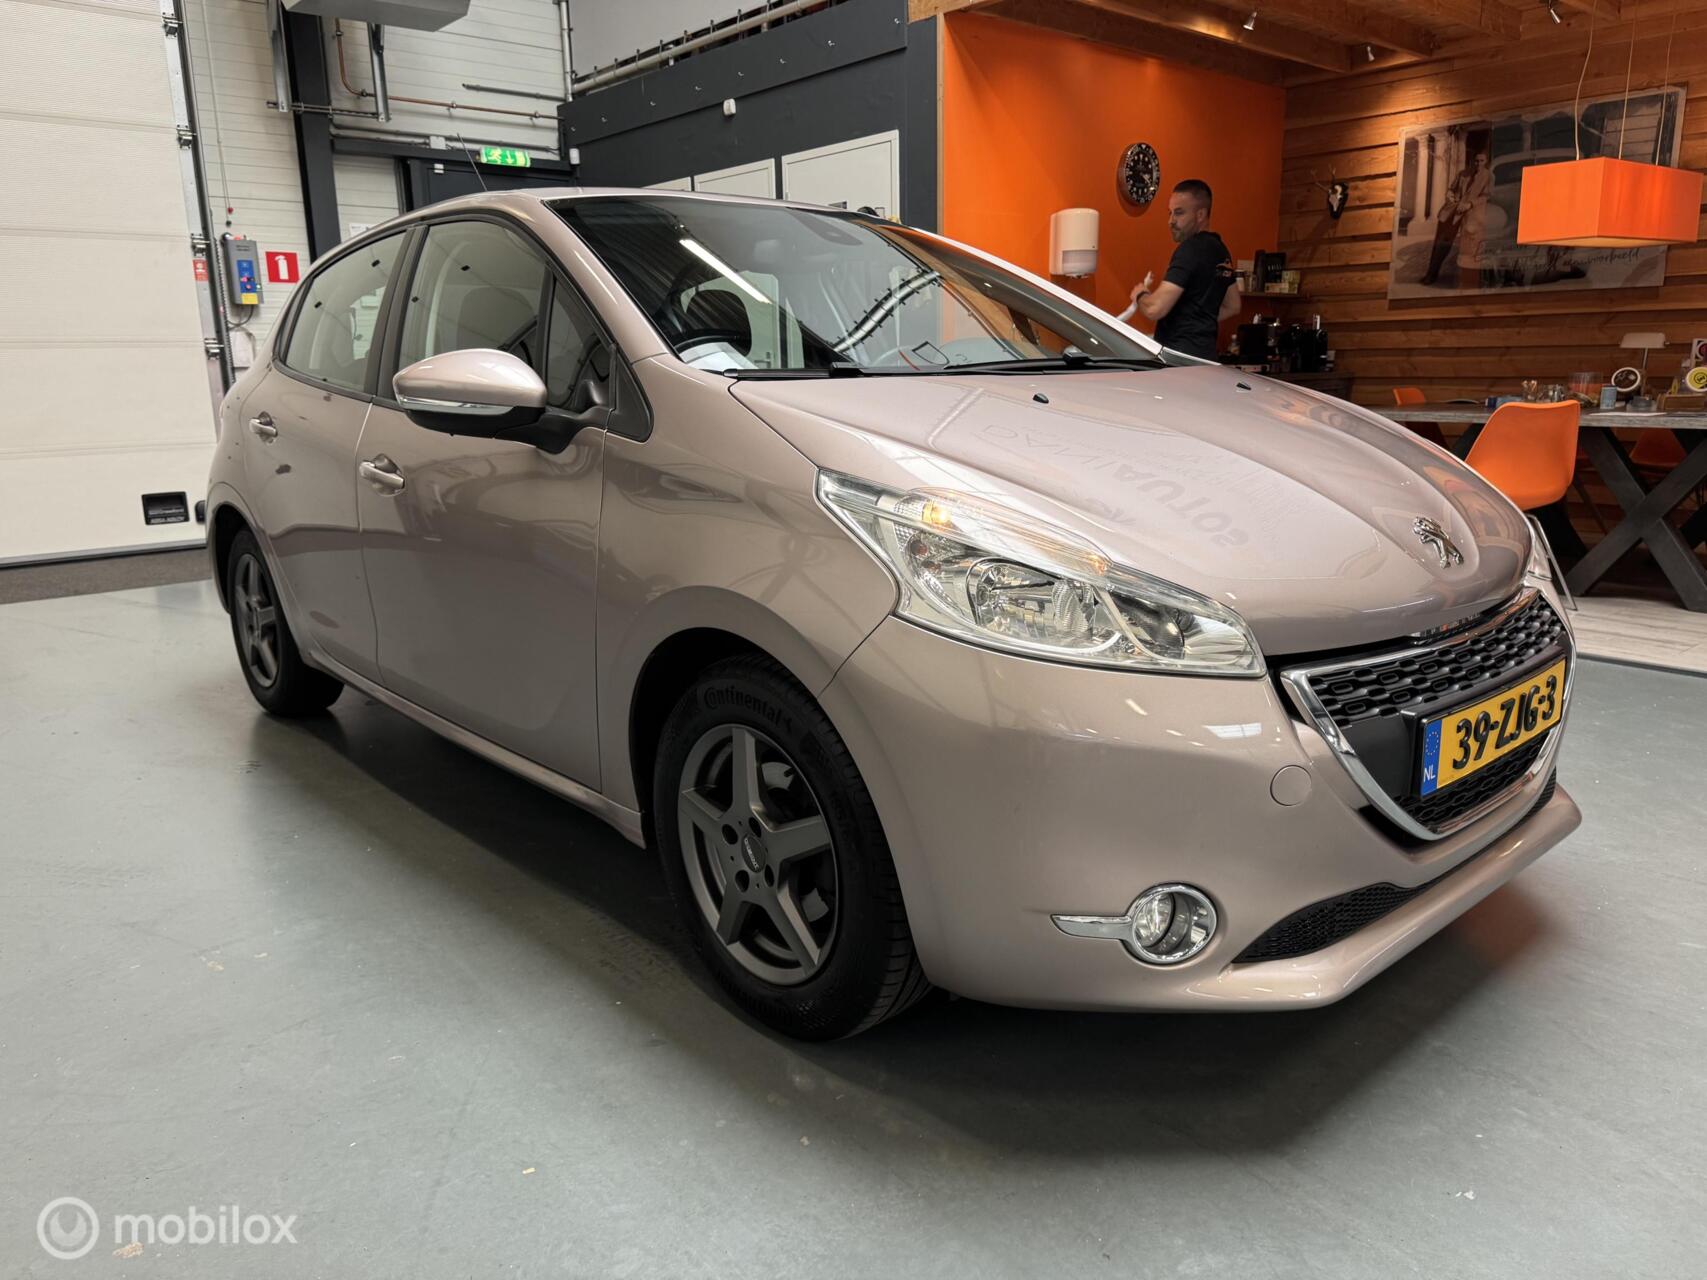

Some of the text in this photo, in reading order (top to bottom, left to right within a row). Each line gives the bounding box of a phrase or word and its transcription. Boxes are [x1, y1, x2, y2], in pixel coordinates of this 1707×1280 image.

[704, 684, 782, 727] Continental
[1452, 674, 1557, 770] 39-ZJG-3
[1423, 765, 1436, 783] NL
